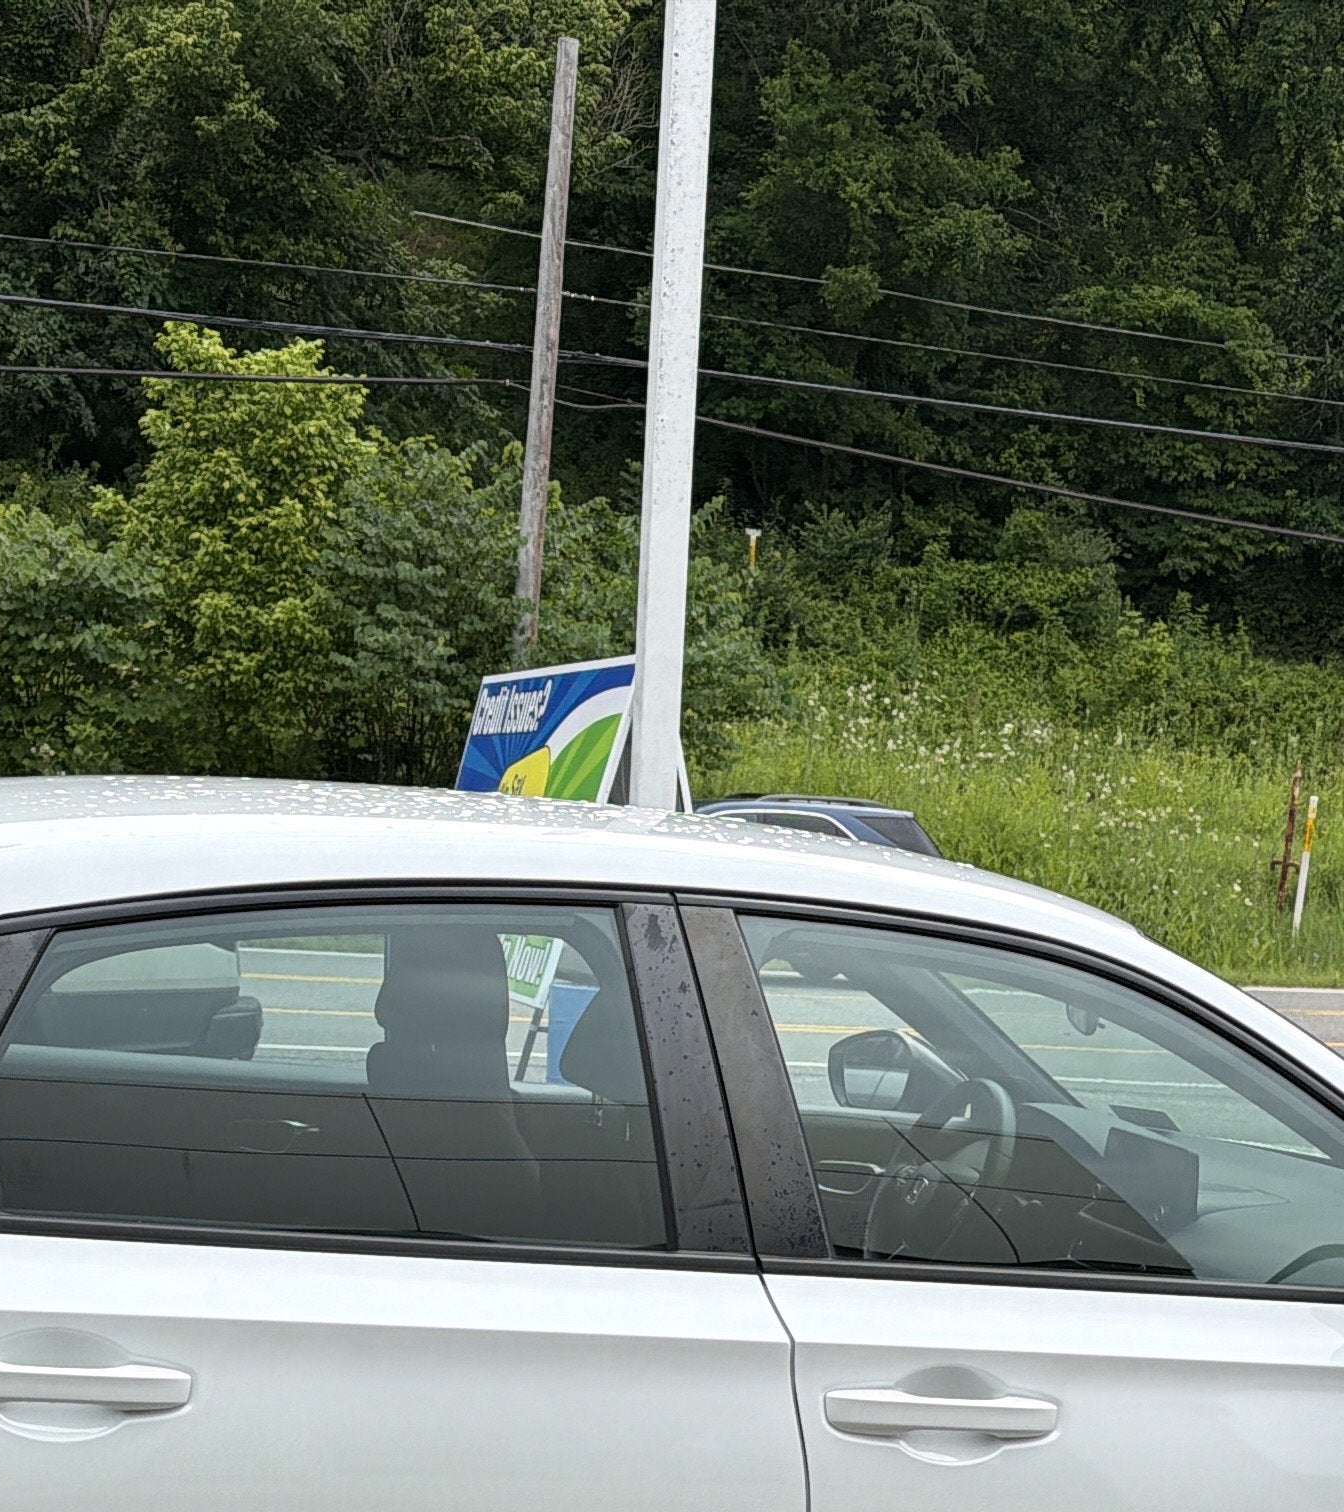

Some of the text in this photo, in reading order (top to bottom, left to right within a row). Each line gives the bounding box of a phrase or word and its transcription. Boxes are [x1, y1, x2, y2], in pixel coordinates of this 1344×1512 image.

[472, 679, 552, 735] Credit Issues?
[506, 935, 551, 985] Now!
